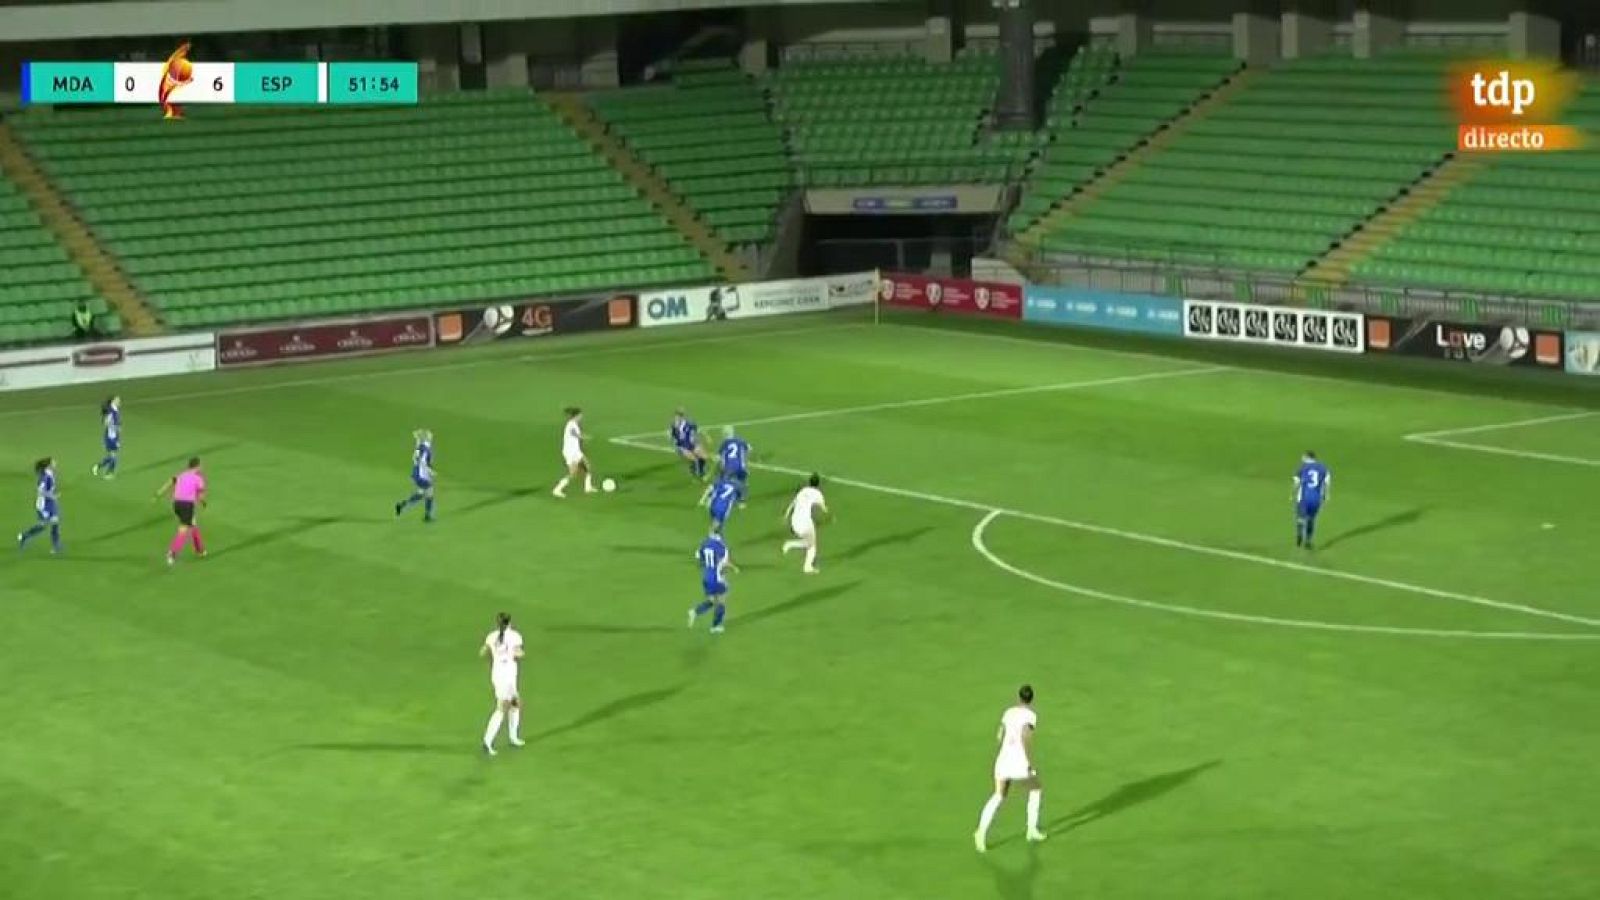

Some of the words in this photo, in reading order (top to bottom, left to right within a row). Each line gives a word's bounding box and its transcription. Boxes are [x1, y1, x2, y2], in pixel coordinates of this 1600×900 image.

[521, 305, 553, 328] 4G
[647, 296, 688, 320] OM
[1436, 324, 1487, 351] Love
[727, 443, 738, 459] 2
[1307, 469, 1319, 488] 3
[720, 484, 734, 500] 7
[703, 547, 715, 568] 11
